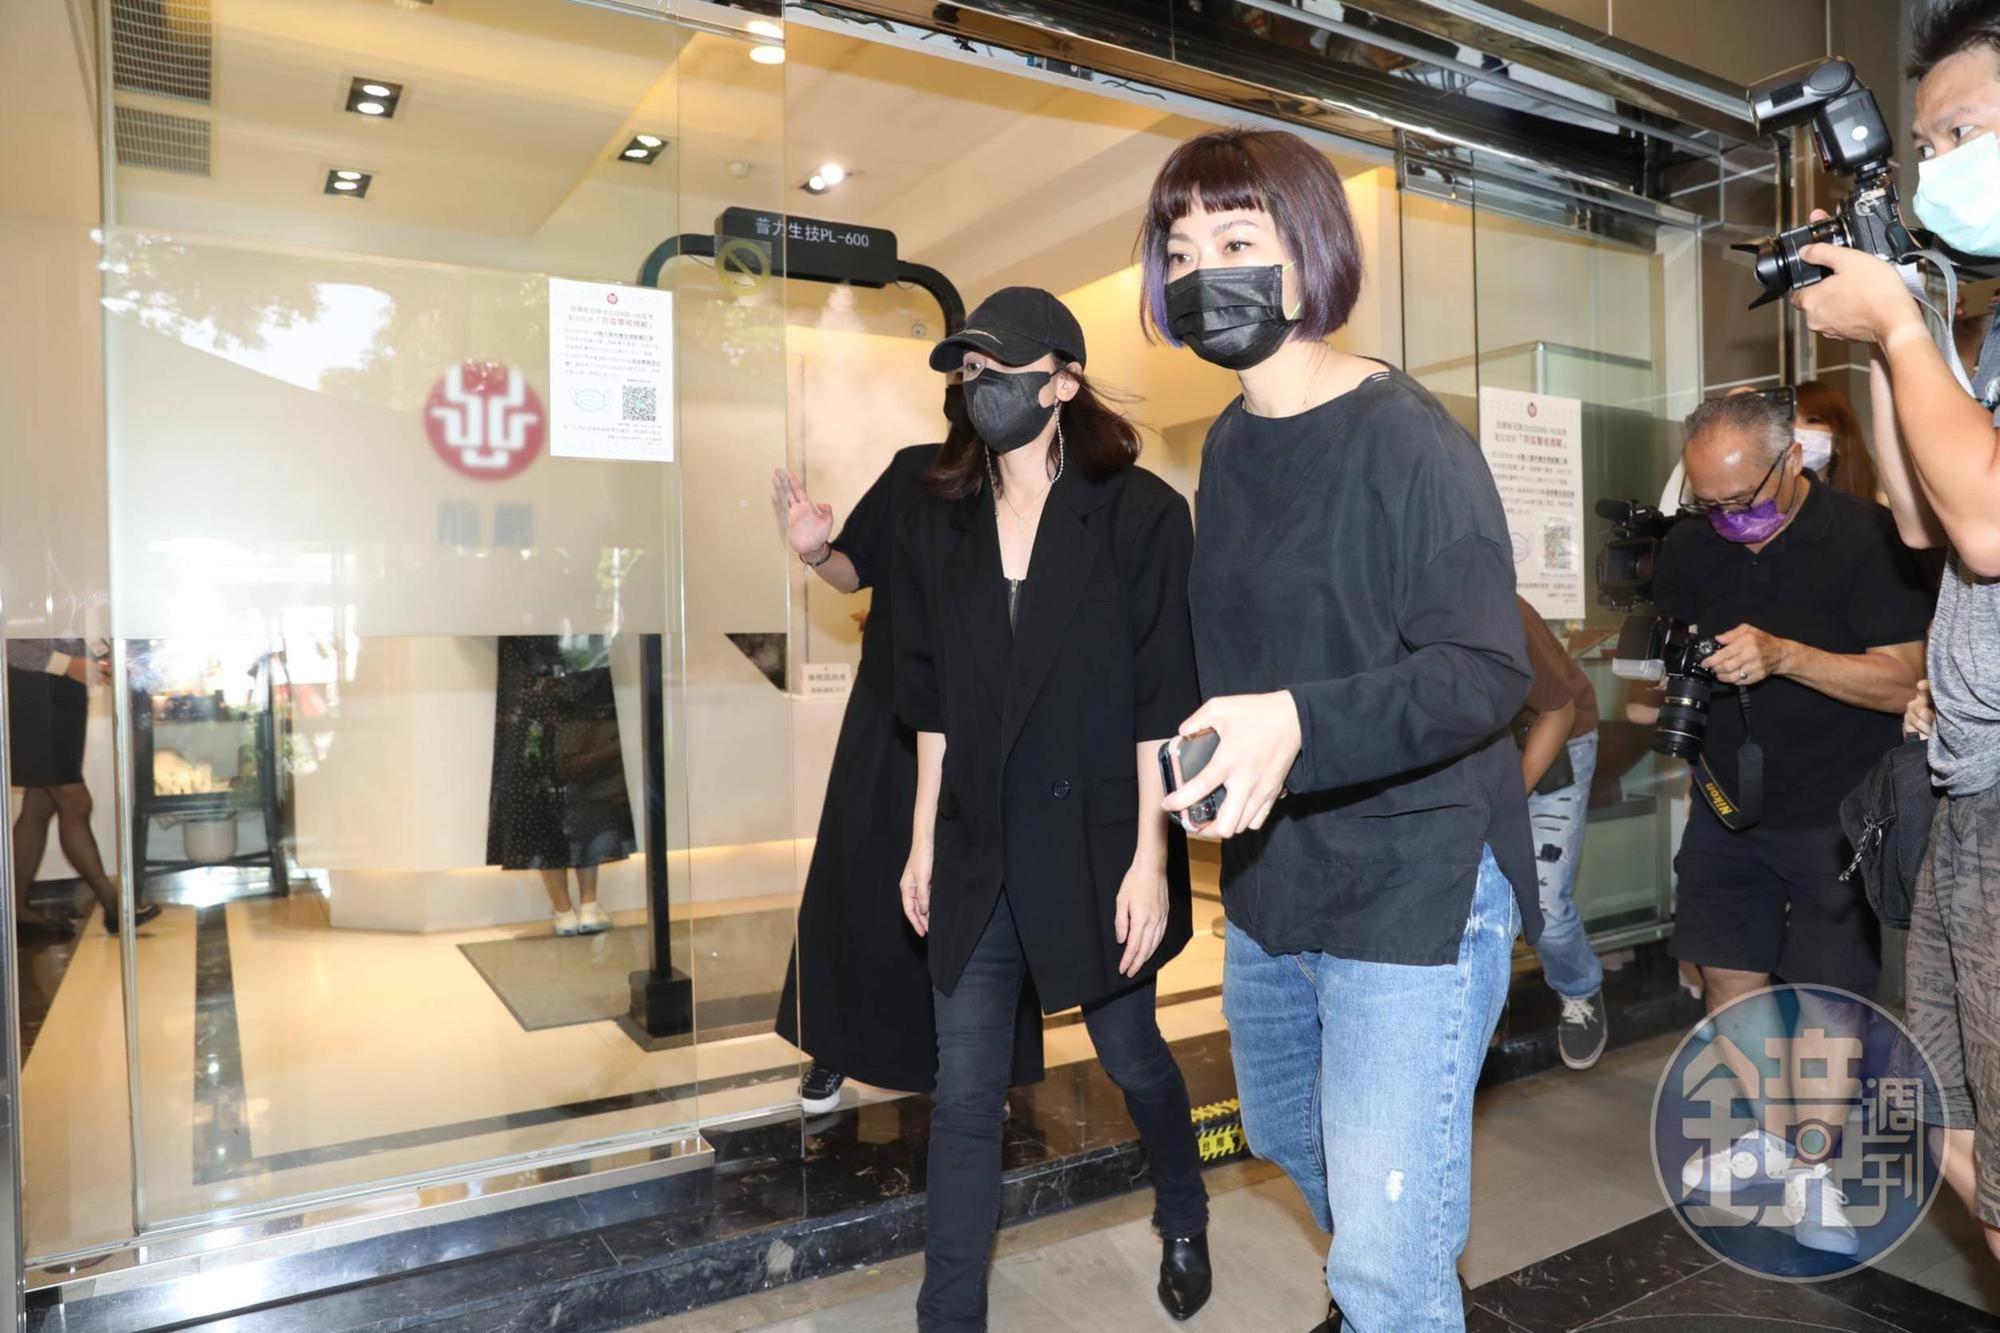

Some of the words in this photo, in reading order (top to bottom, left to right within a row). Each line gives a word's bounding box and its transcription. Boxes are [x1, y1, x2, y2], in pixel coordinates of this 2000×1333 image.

[754, 216, 870, 248] 普力生技PL-600
[1705, 782, 1733, 815] Nikon
